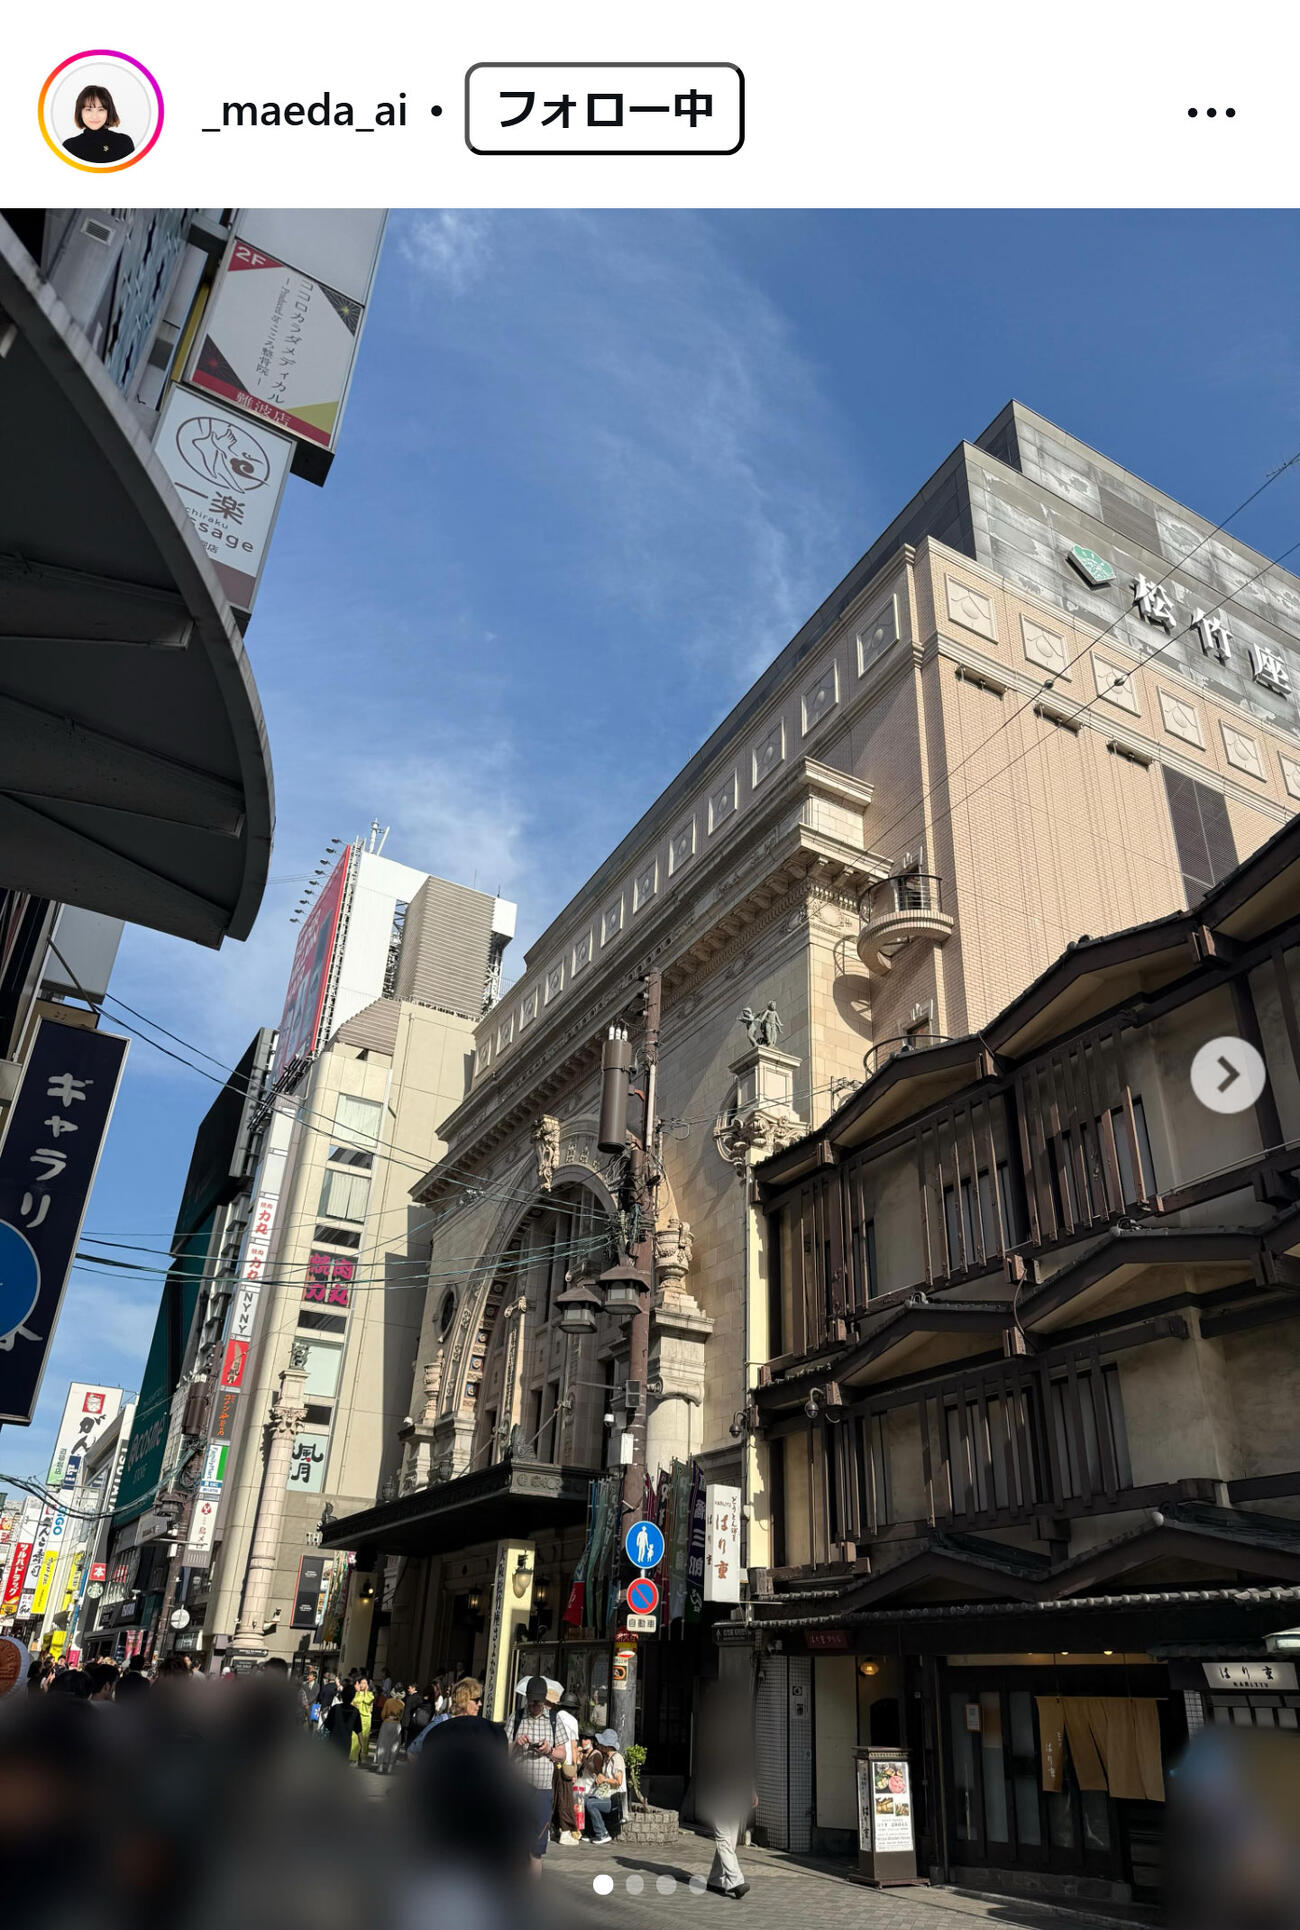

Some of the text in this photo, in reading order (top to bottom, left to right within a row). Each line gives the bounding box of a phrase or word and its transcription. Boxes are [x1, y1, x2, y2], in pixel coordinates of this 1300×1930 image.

[236, 246, 266, 266] 2F
[267, 280, 314, 404] ココロカラダメディカル
[174, 482, 245, 525] 一楽
[184, 506, 229, 530] chiraku
[1133, 572, 1293, 696] 松竹座
[308, 1253, 353, 1280] 焼肉
[238, 1292, 252, 1334] NYNY
[305, 1283, 348, 1305] 力丸
[291, 1443, 324, 1483] 風月
[714, 1514, 729, 1580] はり重
[9, 1543, 29, 1597] ツルハドラッグ
[93, 1566, 106, 1578] 本
[1219, 1666, 1274, 1680] はり重
